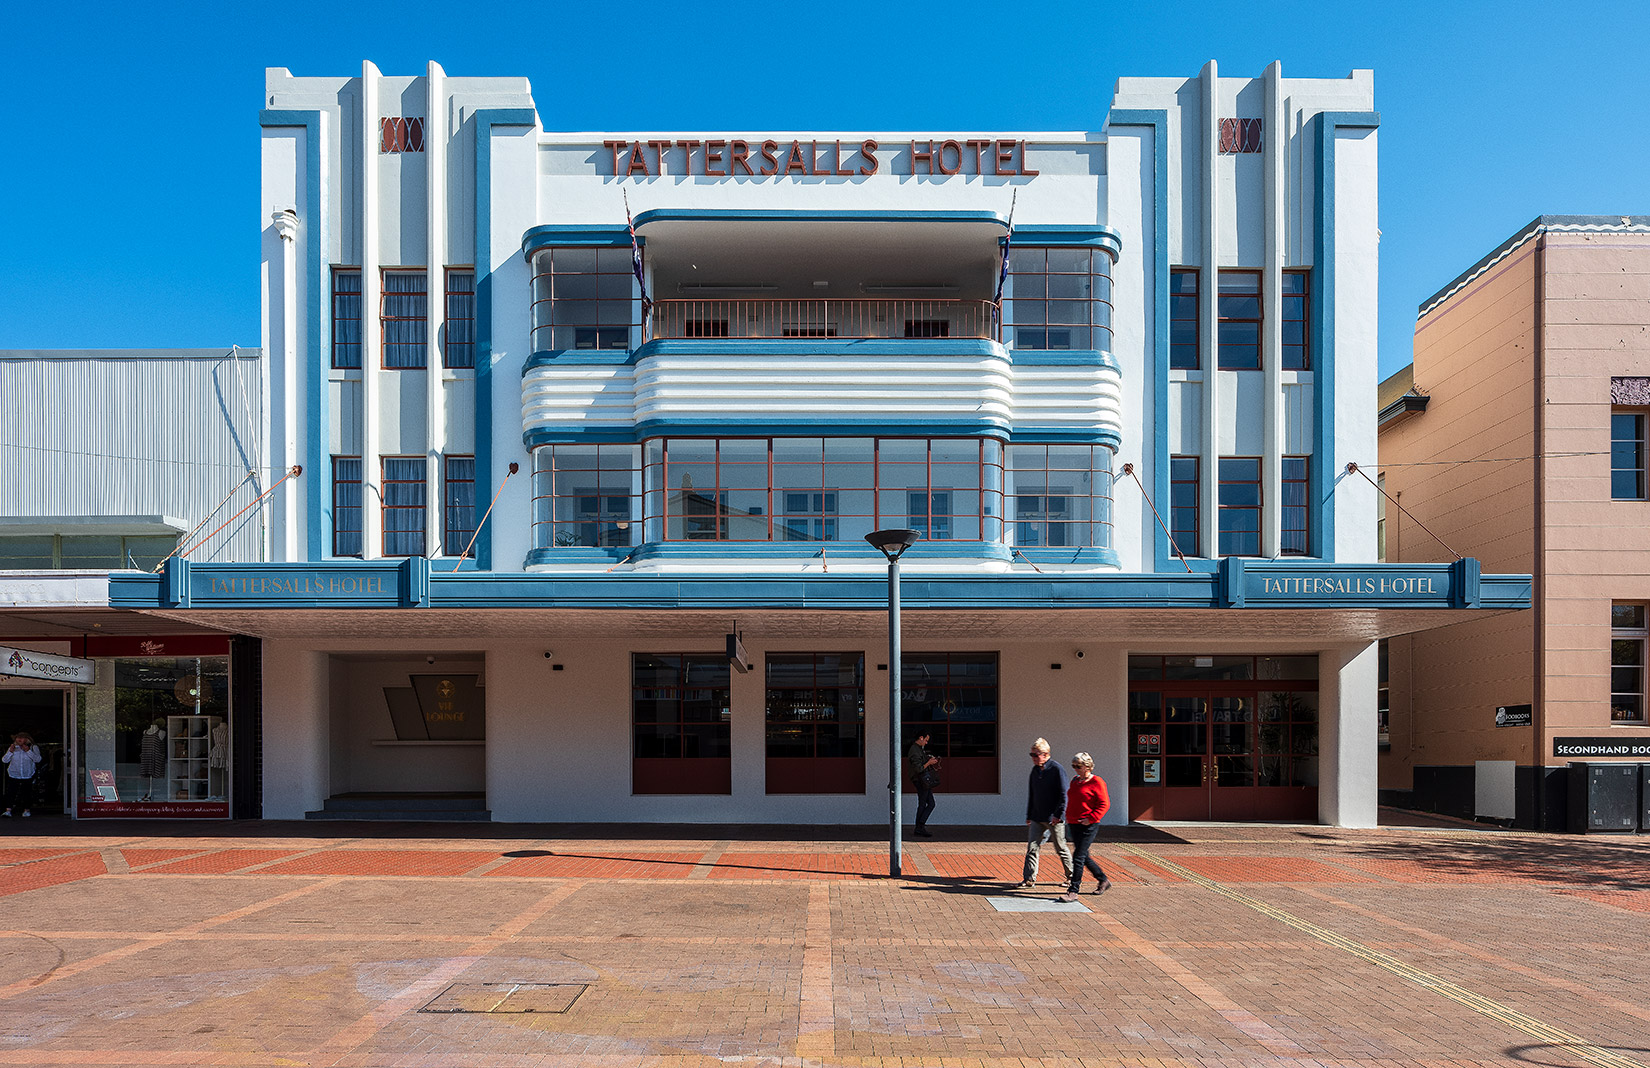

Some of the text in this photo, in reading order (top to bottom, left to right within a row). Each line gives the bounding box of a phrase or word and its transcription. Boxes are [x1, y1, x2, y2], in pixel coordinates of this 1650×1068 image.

[604, 139, 1039, 177] TATTERSALLS HOTEL
[209, 577, 387, 593] TATTERSALLS HOTEL
[1262, 577, 1437, 594] TATTERSALLS HOTEL
[31, 661, 79, 676] concepts
[1557, 745, 1629, 754] SECONDHAND
